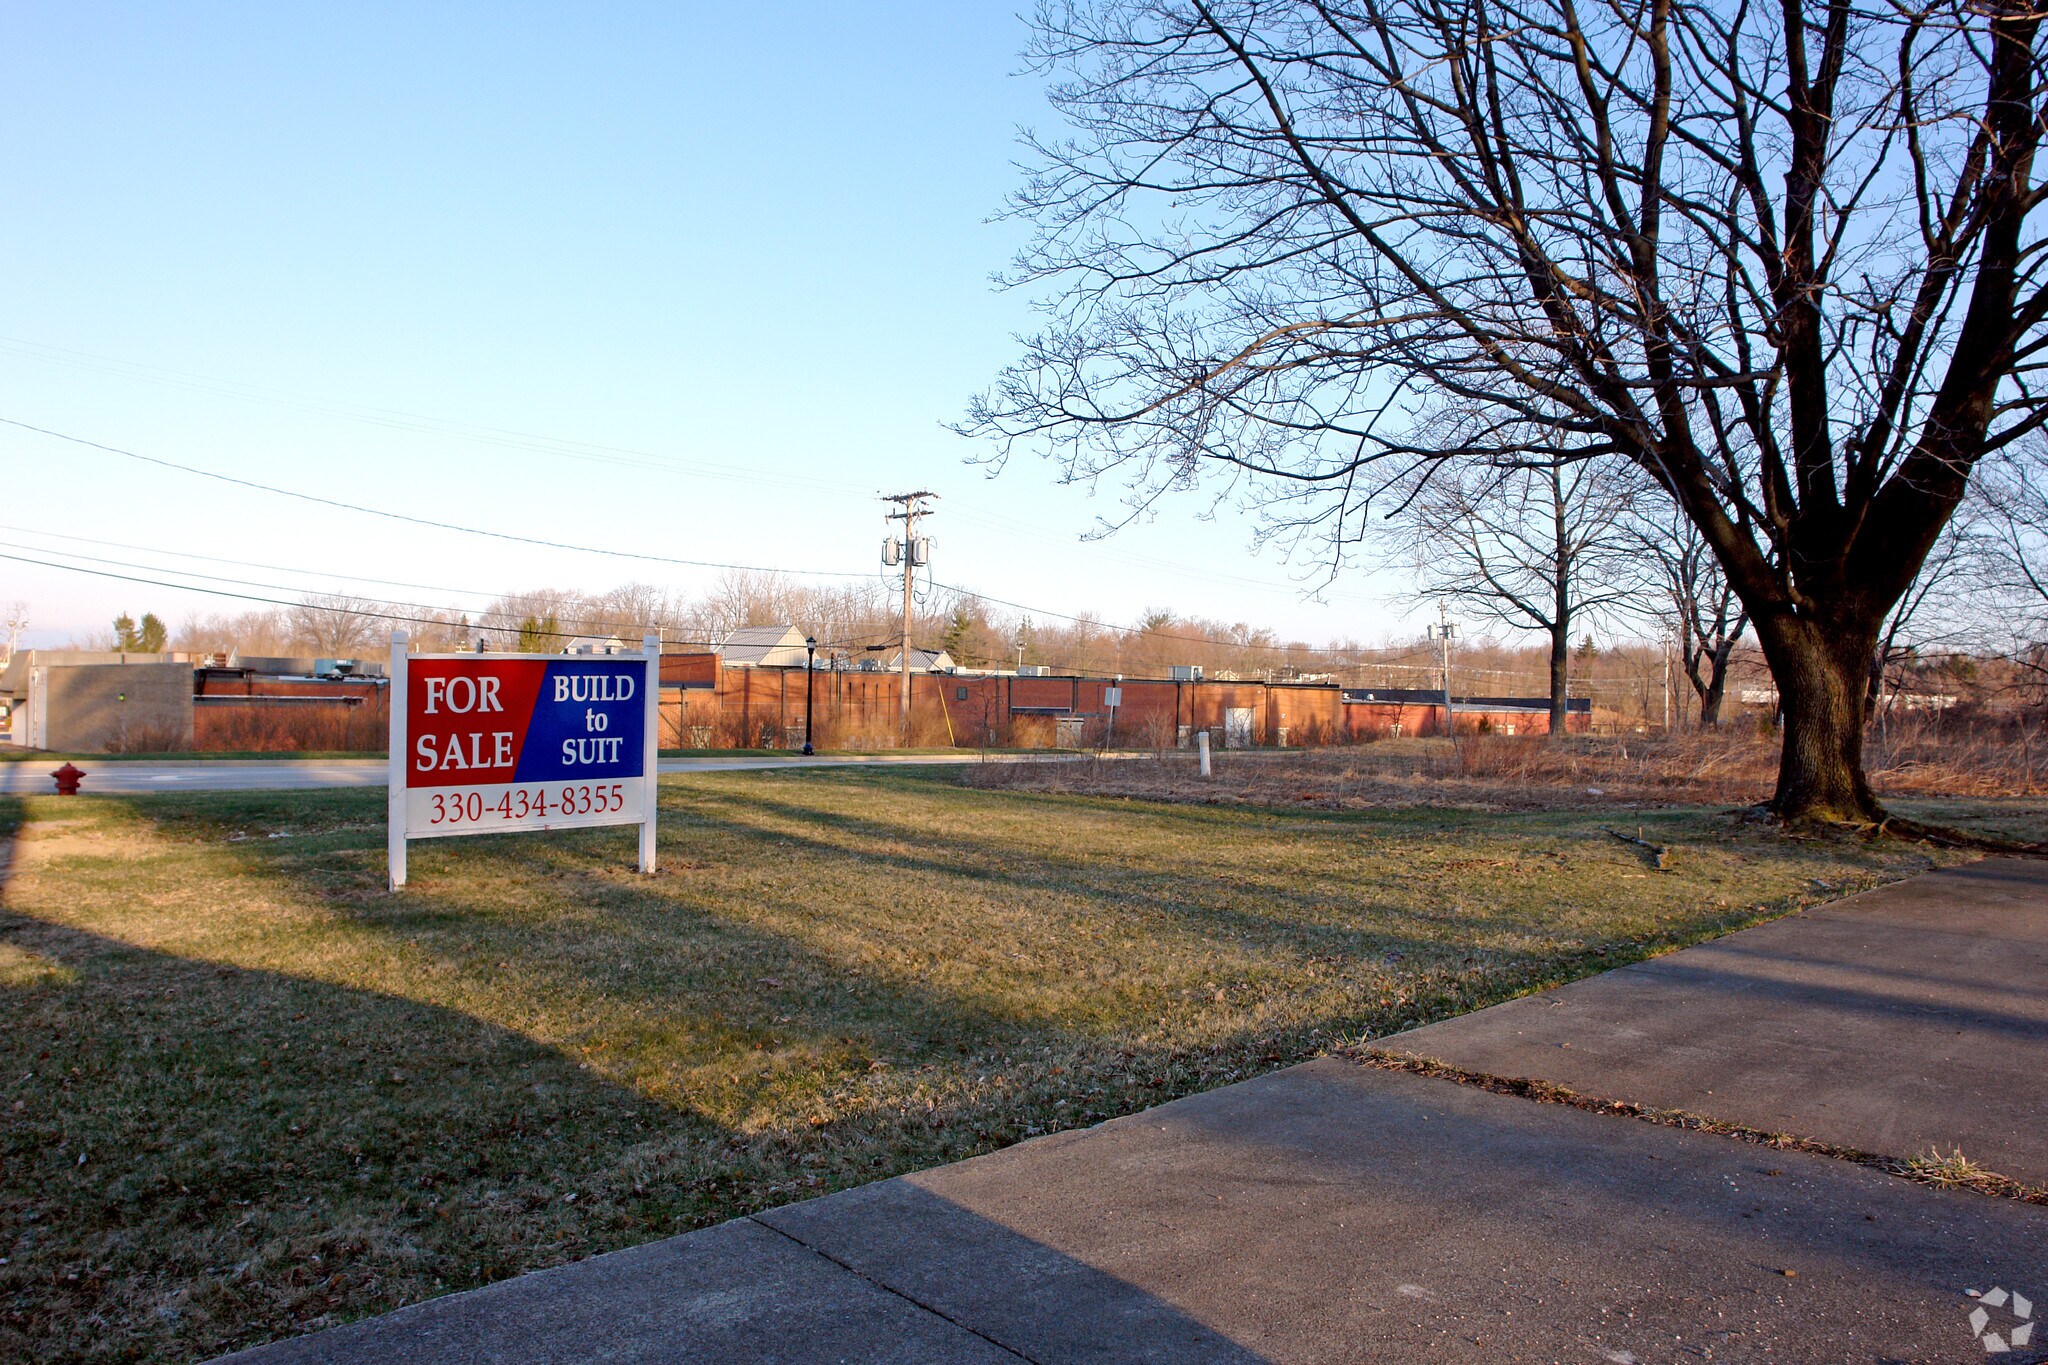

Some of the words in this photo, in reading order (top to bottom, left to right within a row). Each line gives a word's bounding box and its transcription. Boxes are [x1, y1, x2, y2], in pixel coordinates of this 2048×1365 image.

[424, 677, 503, 714] FOR
[553, 676, 634, 702] BUILD
[586, 708, 608, 731] to
[417, 732, 513, 771] SALE
[562, 737, 623, 765] SUIT
[431, 785, 623, 823] 330-434-8355
